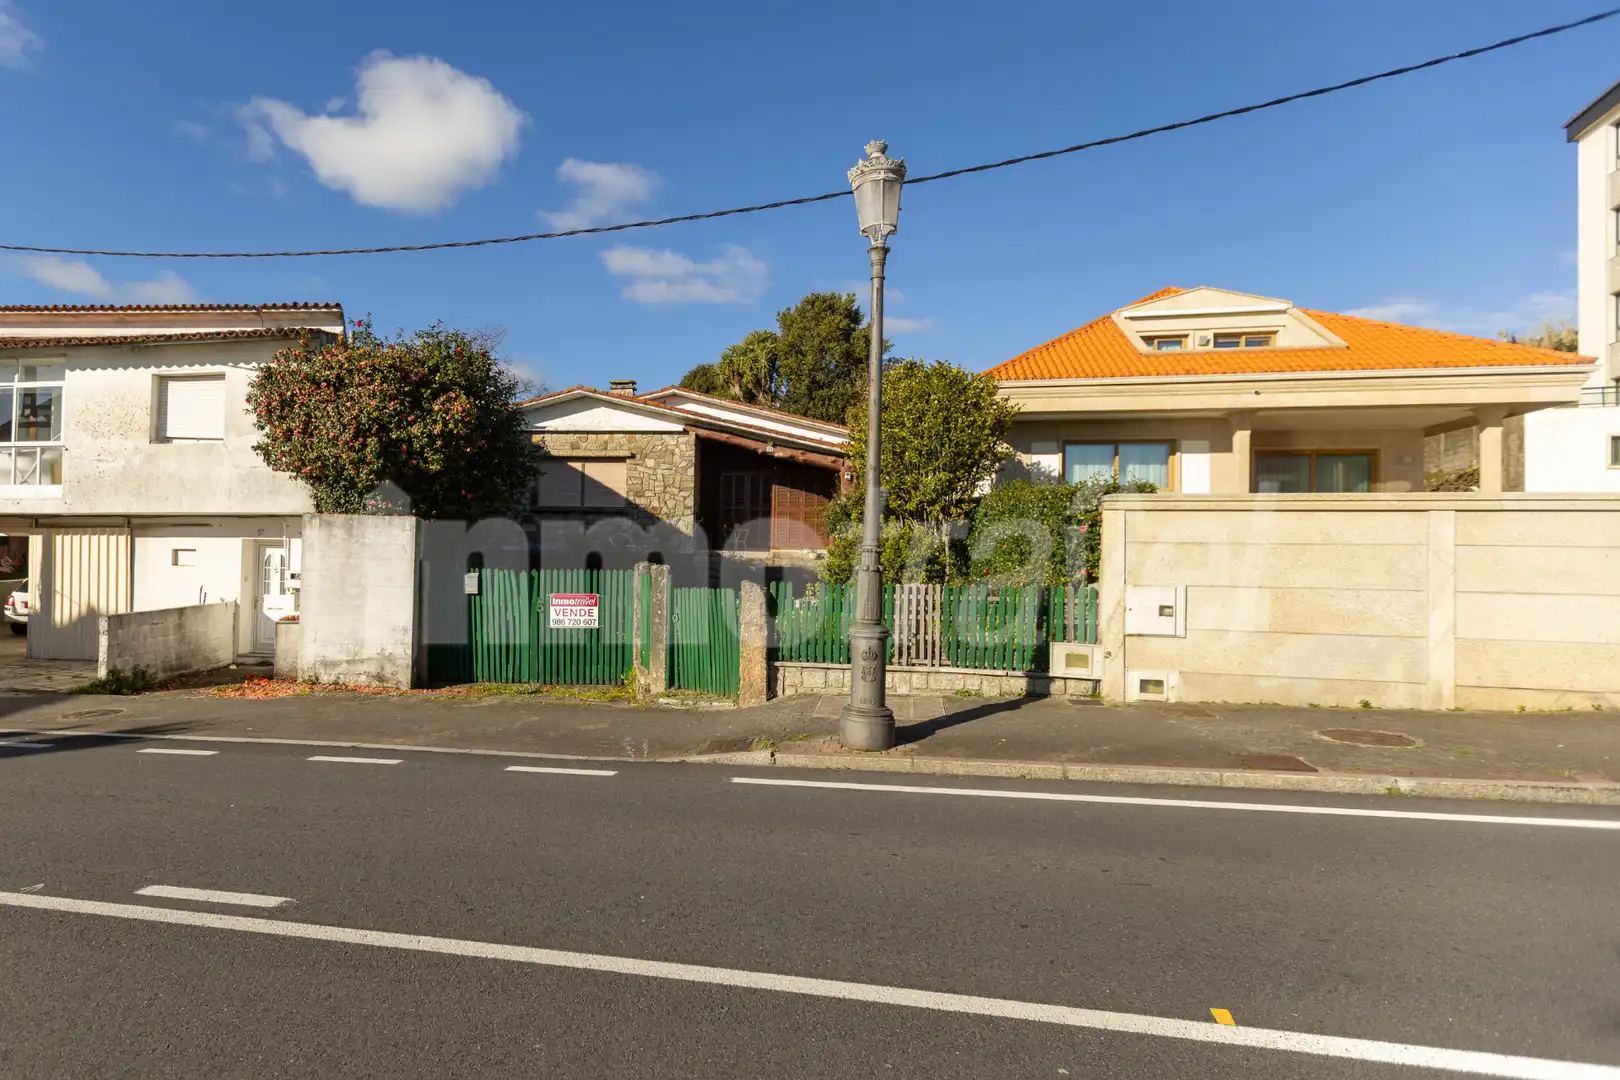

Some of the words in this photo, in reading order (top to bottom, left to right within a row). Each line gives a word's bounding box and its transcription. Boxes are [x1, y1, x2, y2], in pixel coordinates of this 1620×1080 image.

[554, 608, 595, 617] VENDE
[552, 618, 566, 626] 986
[568, 618, 581, 626] 720
[583, 618, 597, 626] 607
